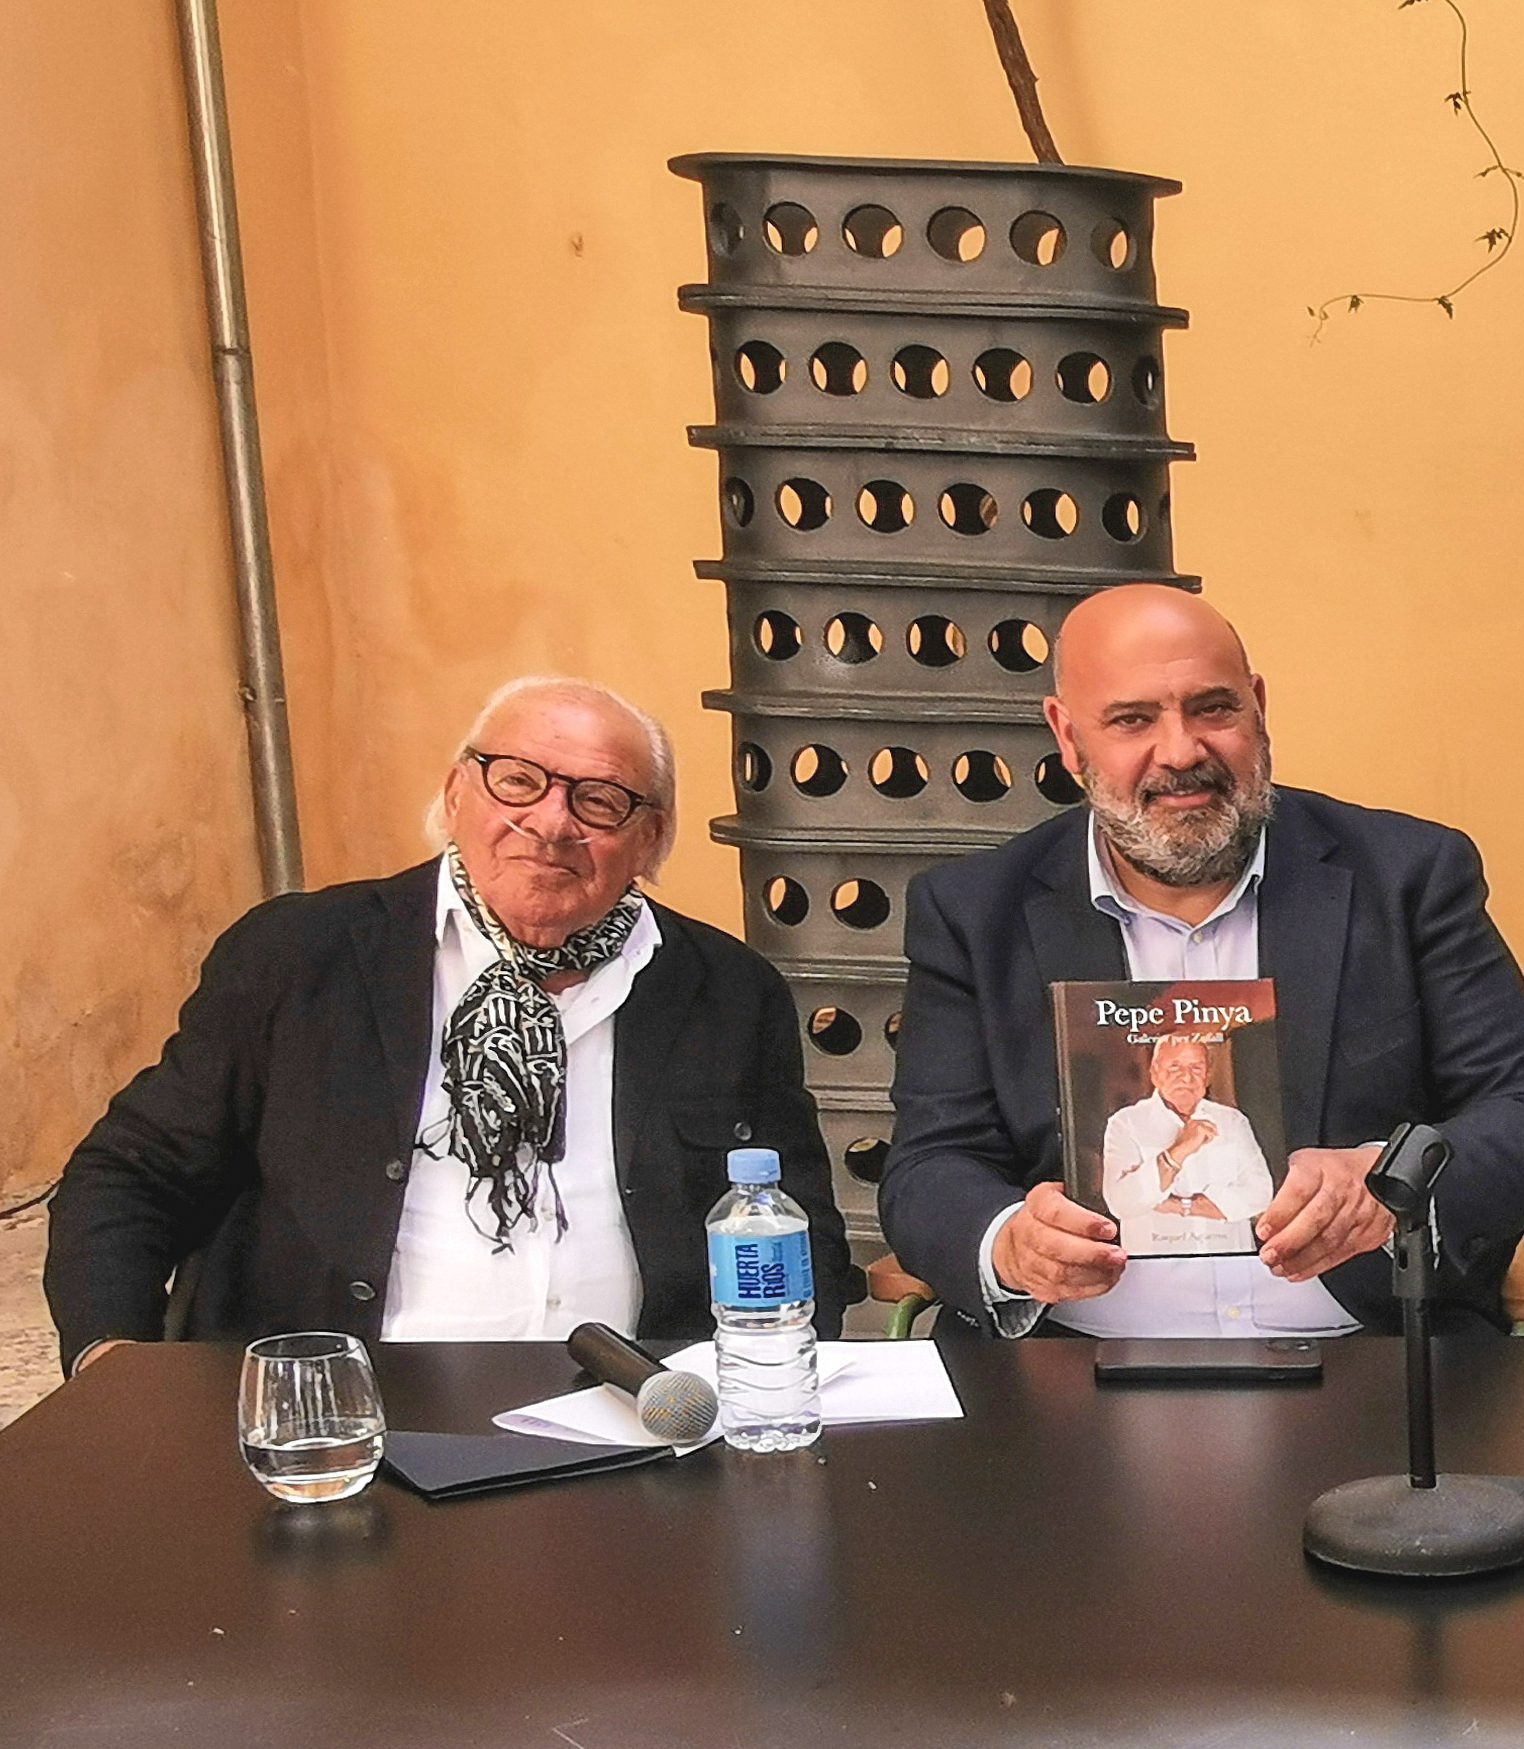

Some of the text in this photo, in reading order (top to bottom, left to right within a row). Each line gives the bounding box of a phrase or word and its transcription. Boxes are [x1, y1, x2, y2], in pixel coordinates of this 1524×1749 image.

[1095, 998, 1253, 1032] Pepe Pinya
[735, 1244, 762, 1298] HUERTA
